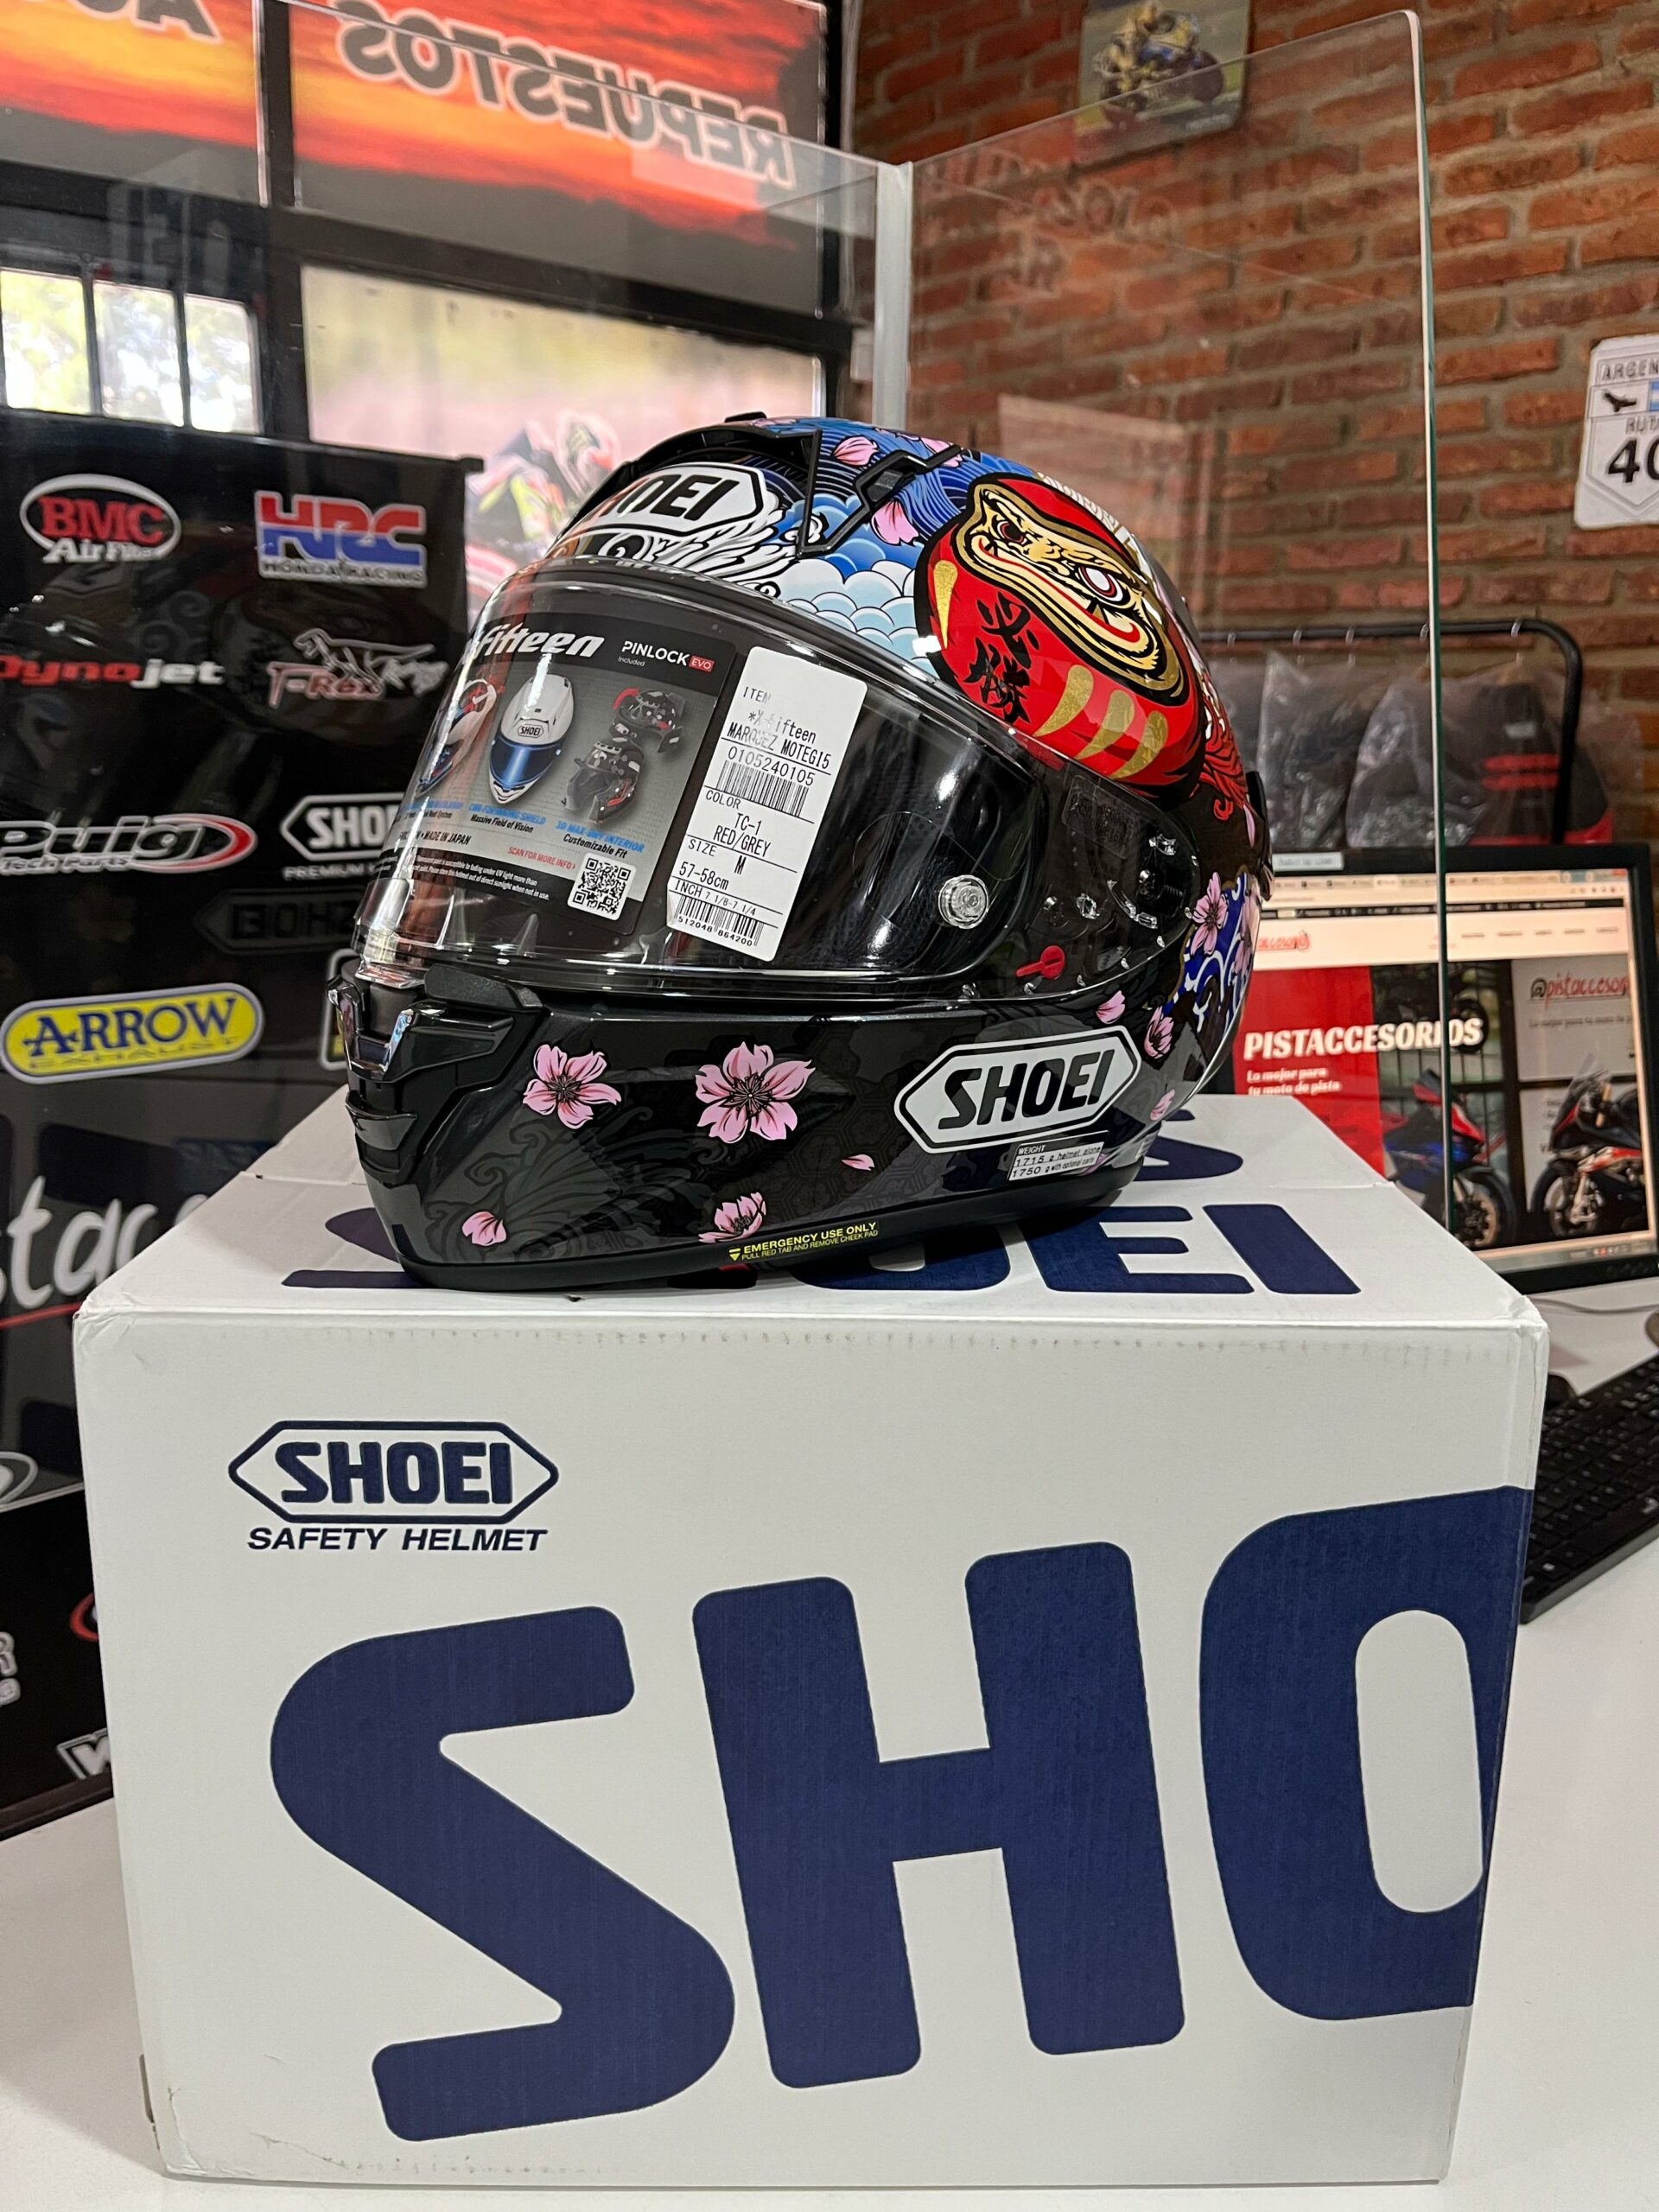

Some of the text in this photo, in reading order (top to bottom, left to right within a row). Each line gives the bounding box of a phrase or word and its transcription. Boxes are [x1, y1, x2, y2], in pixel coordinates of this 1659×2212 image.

[615, 474, 741, 521] OEI
[38, 496, 164, 547] BMC
[258, 493, 426, 566] HRC
[264, 562, 339, 577] HONDA
[618, 656, 645, 667] Included
[621, 640, 713, 671] PINLOCK EVO
[0, 655, 226, 689] Dynojet
[520, 726, 541, 735] SHOEI
[728, 746, 815, 786] 0105240105
[780, 739, 831, 769] MOTEGI5
[705, 789, 741, 810] COLOR
[305, 804, 399, 850] SHO
[470, 814, 493, 824] Massive
[492, 817, 507, 827] Field
[513, 822, 534, 833] Vision
[734, 812, 762, 836] TC-1
[0, 814, 206, 861] Puig
[423, 830, 442, 842] MADE
[440, 832, 449, 842] IN
[448, 833, 473, 845] JAPAN
[563, 834, 627, 859] Customizable Fit
[604, 835, 645, 853] INTERIOR
[688, 838, 717, 857] SIZE
[713, 825, 772, 857] RED/GREY
[507, 847, 571, 869] SCAN FOR MORE INFO
[734, 855, 747, 874] M
[283, 863, 364, 880] PREMIUM
[525, 877, 537, 887] than
[679, 861, 729, 890] 57-58cm
[675, 880, 702, 898] INCH
[678, 917, 753, 947] 512048 864200
[23, 995, 238, 1058] ARROW
[1247, 1067, 1328, 1084] Lo mejor para
[1262, 1084, 1294, 1095] moto
[1294, 1080, 1310, 1095] de
[1311, 1079, 1342, 1096] pista
[937, 1048, 1116, 1131] SHOEI
[1015, 1154, 1045, 1166] 1715
[1058, 1150, 1080, 1160] helmet
[1084, 1146, 1102, 1156] alone
[1018, 1145, 1046, 1154] WEIGHT
[1012, 1166, 1041, 1179] 1750
[741, 1229, 878, 1261] PULL RED TAB AND REMOVE CHEEK PAD
[744, 1222, 876, 1255] EMERGENCY USE ONLY
[275, 1441, 513, 1504] SHOEI
[247, 1527, 548, 1551] SAFETY HELMET
[270, 1485, 1531, 2141] SHO
